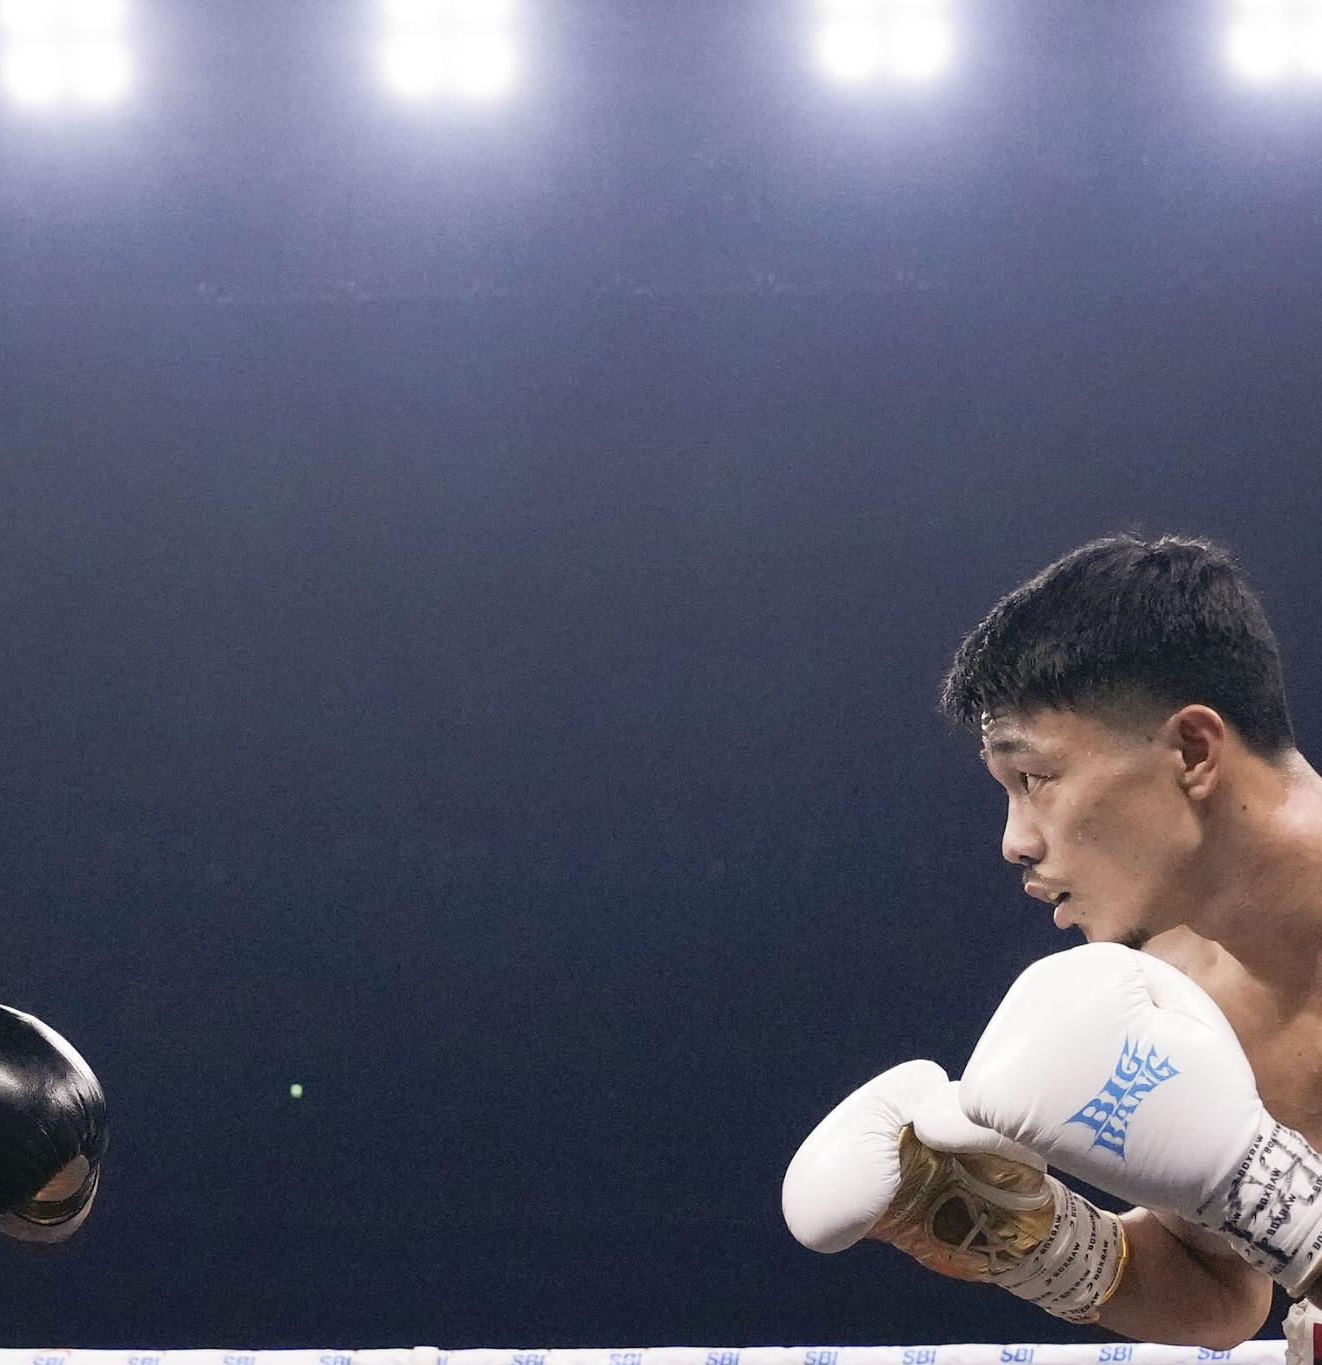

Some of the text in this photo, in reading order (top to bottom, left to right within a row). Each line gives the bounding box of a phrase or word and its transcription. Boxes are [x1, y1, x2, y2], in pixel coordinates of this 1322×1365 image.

[1061, 1032, 1144, 1138] BIG
[1089, 1044, 1181, 1160] BANG
[902, 1349, 937, 1365] SBI
[1000, 1347, 1036, 1364] SBI
[1098, 1346, 1134, 1363] SBI
